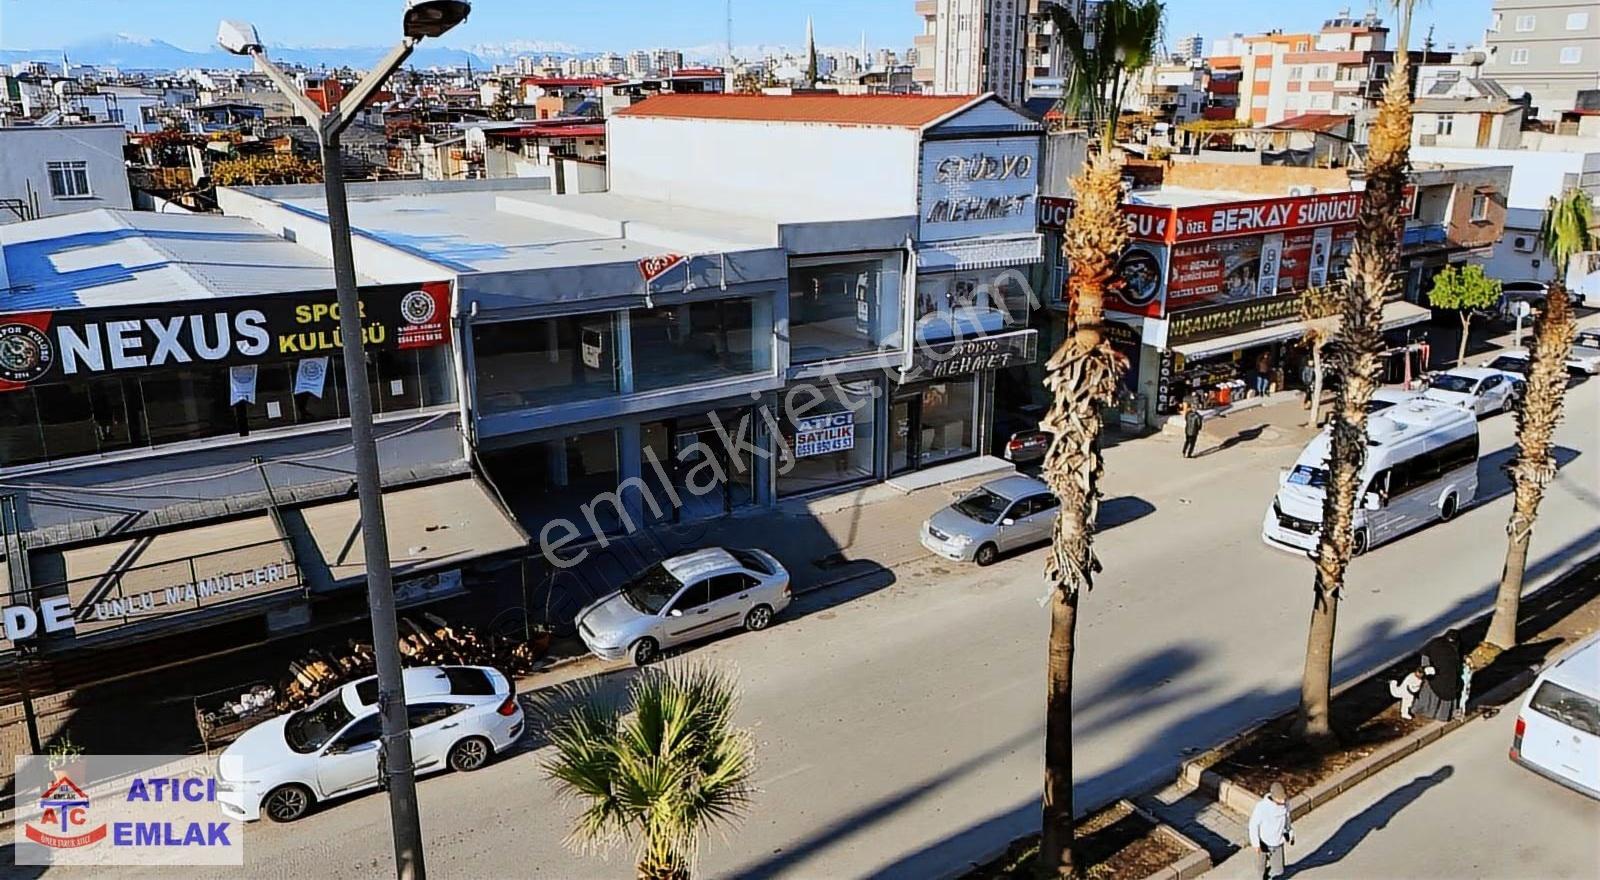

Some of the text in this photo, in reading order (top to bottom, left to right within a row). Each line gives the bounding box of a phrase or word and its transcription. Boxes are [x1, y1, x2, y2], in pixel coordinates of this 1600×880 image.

[935, 152, 1032, 183] STÜDYO
[927, 194, 1033, 222] MEHMET
[1211, 203, 1294, 233] BERKAY
[1297, 194, 1357, 224] SÜRÜCÜ
[1170, 309, 1240, 337] NİŞANTAŞI
[57, 310, 270, 374] NEXUS
[933, 353, 1013, 377] MEHMET
[798, 427, 851, 444] SATILIK
[4, 595, 75, 641] DE
